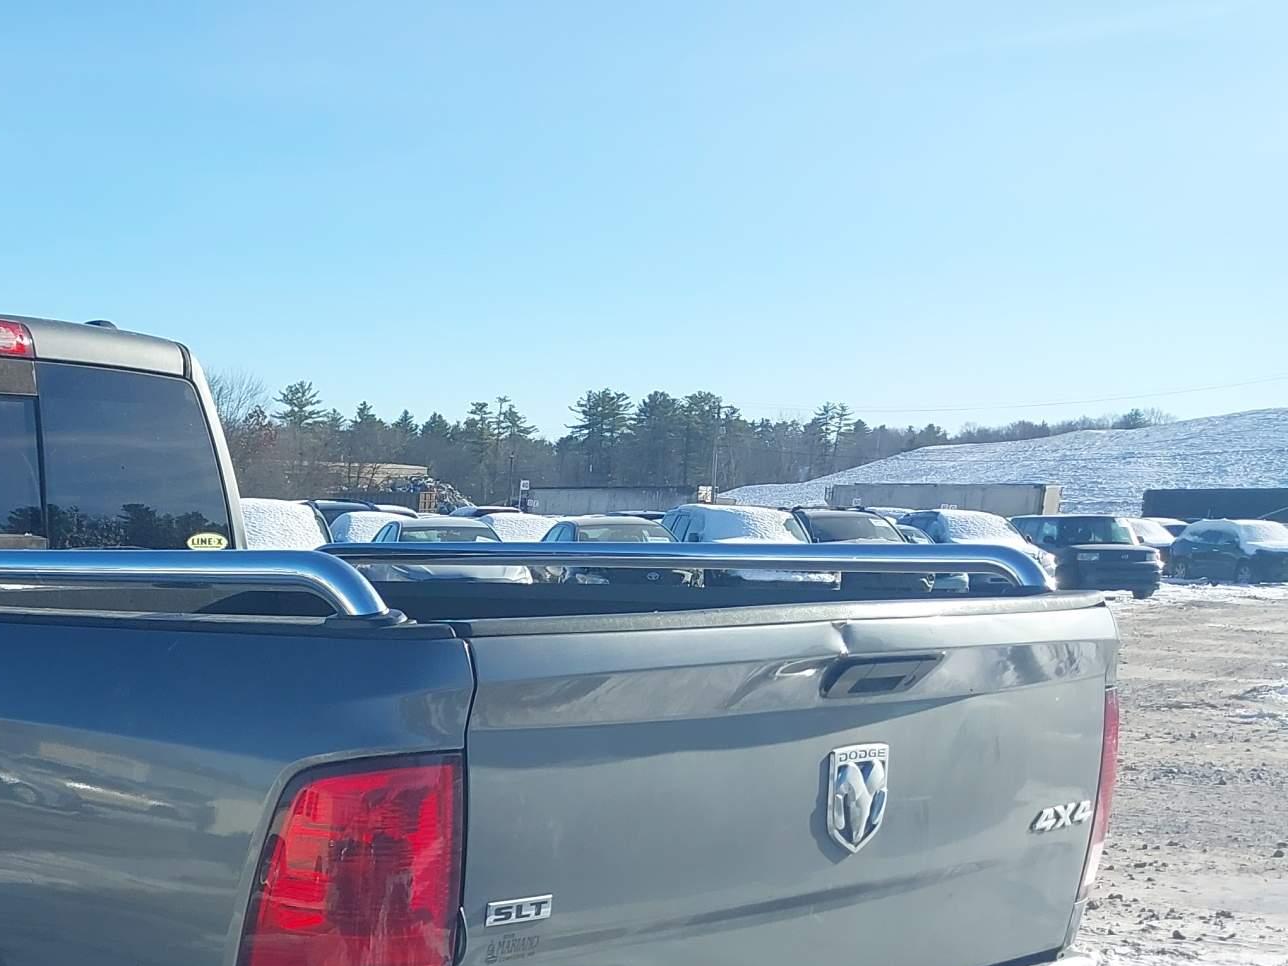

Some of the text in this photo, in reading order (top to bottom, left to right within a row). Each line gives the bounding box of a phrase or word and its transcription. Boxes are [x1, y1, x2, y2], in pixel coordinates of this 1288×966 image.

[839, 748, 886, 762] DODGE
[1031, 800, 1093, 832] 4X4
[493, 901, 548, 922] SLT
